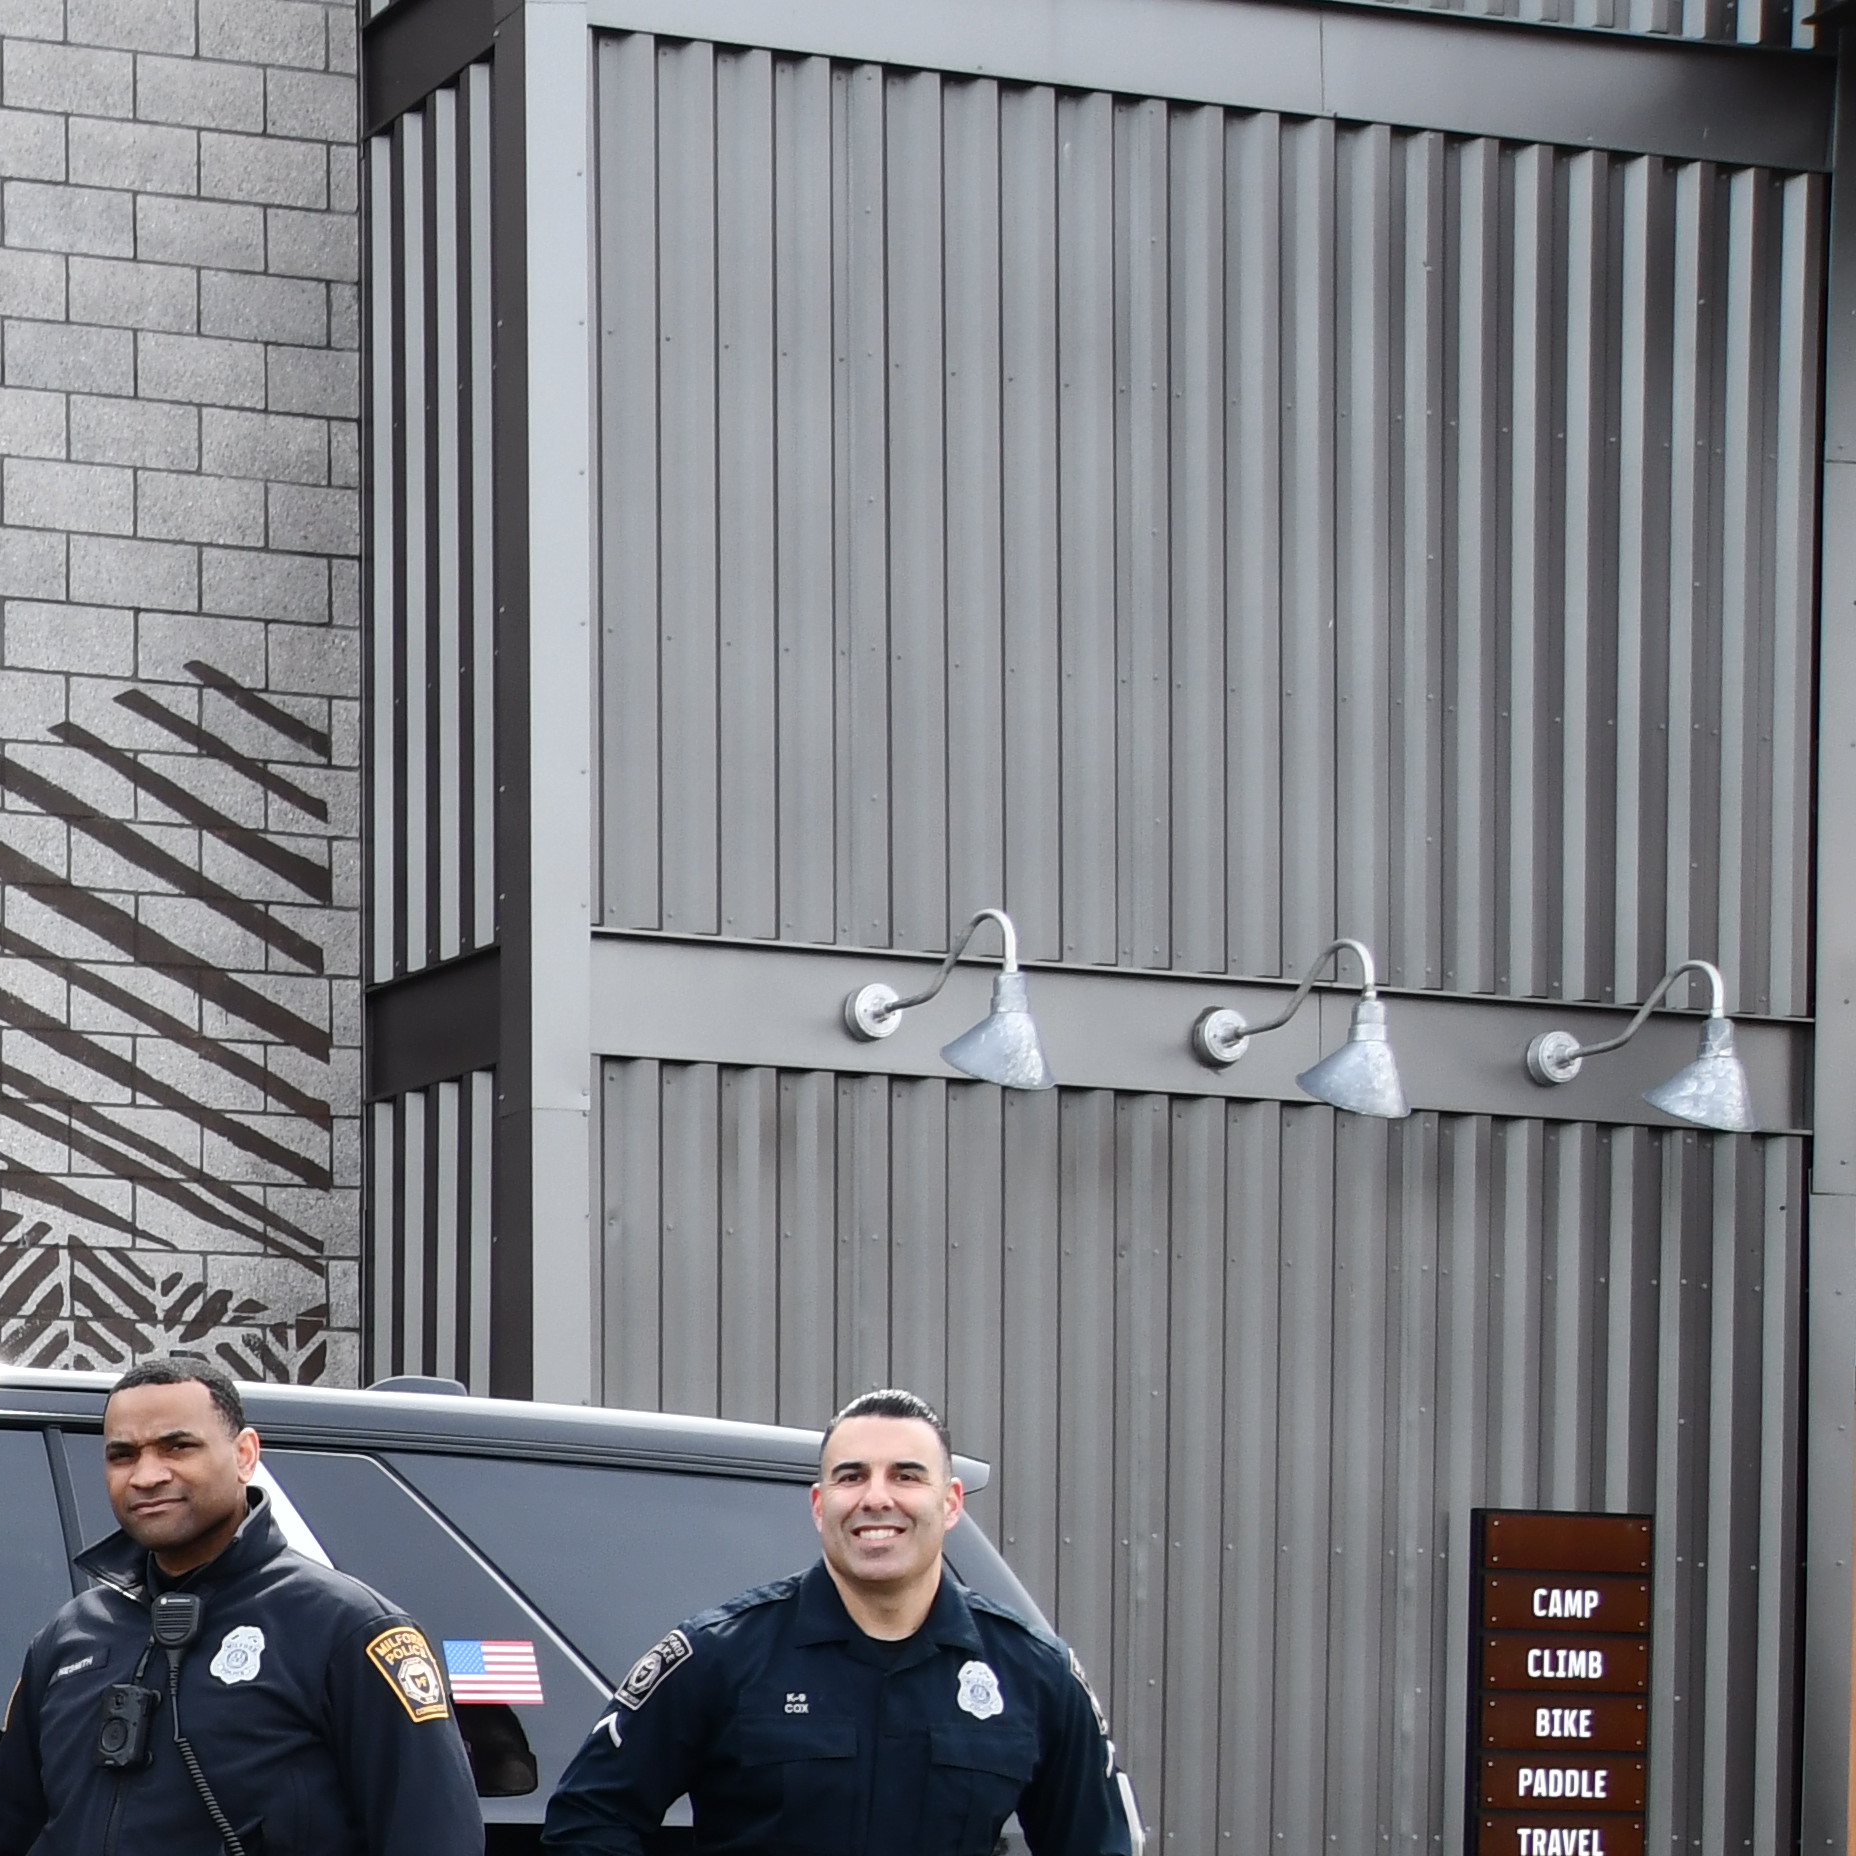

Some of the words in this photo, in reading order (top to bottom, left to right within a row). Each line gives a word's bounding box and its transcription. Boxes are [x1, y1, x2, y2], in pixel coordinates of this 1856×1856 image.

[1532, 1587, 1600, 1619] CAMP
[374, 1633, 424, 1657] MILFORD
[384, 1644, 428, 1666] POLICE
[1526, 1648, 1604, 1679] CLIMB
[784, 1703, 809, 1713] COX
[786, 1693, 807, 1702] K-9
[1535, 1707, 1593, 1738] BIKE
[1518, 1767, 1608, 1799] PADDLE
